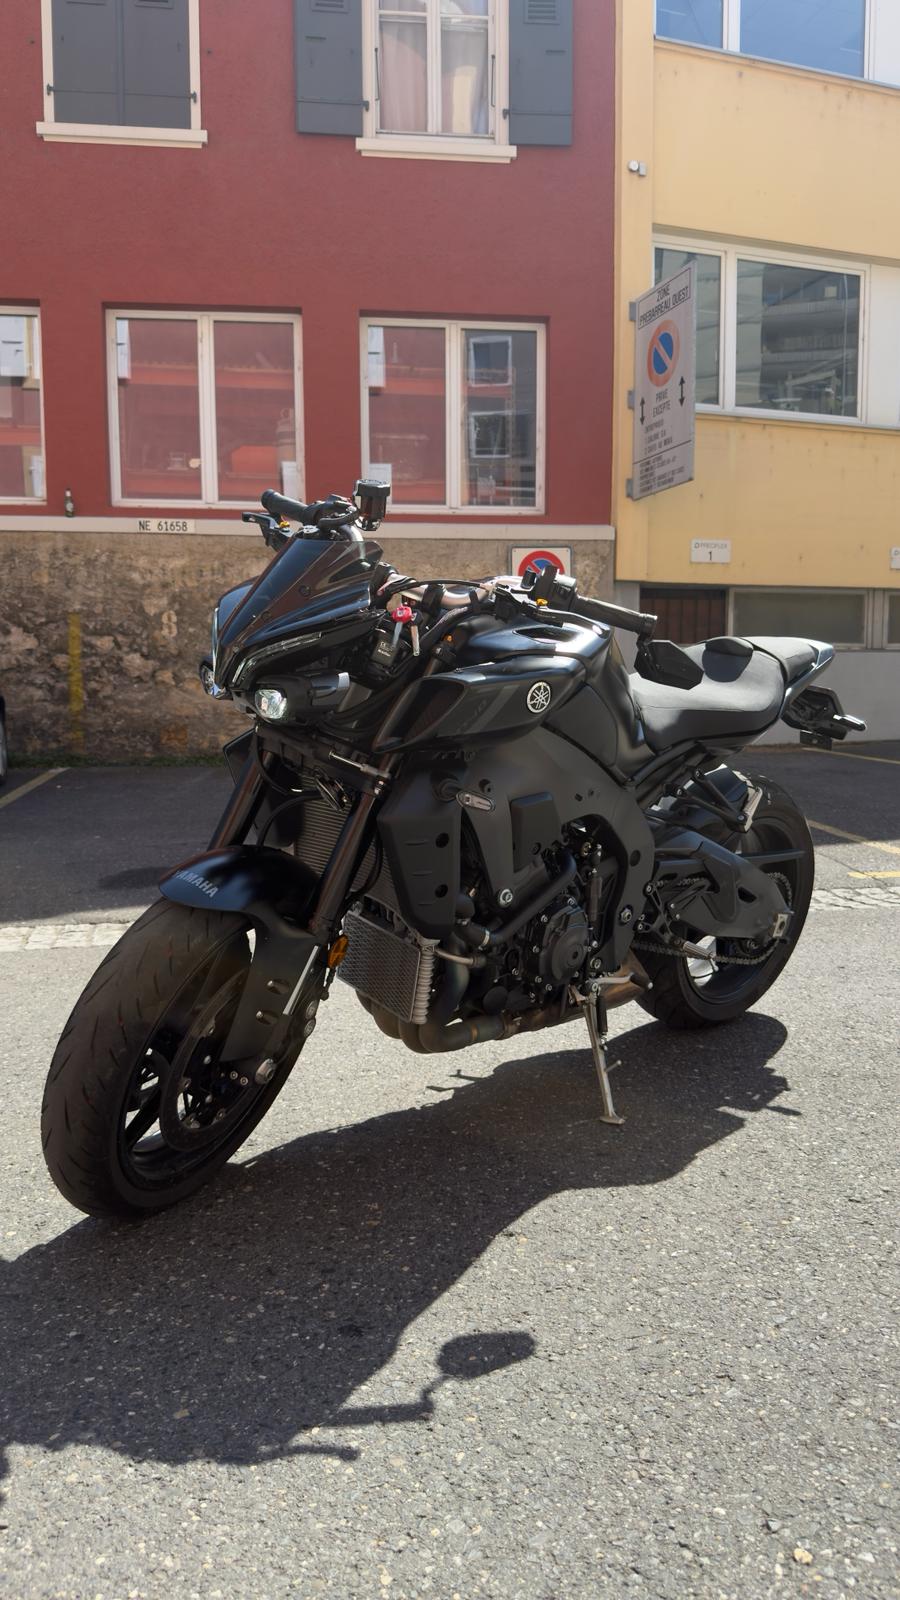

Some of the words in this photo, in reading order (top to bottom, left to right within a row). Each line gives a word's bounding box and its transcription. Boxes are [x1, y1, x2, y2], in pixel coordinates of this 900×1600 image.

[656, 284, 670, 302] ZONE
[672, 286, 689, 306] OUEST
[138, 520, 151, 531] NE
[157, 520, 188, 532] 61658
